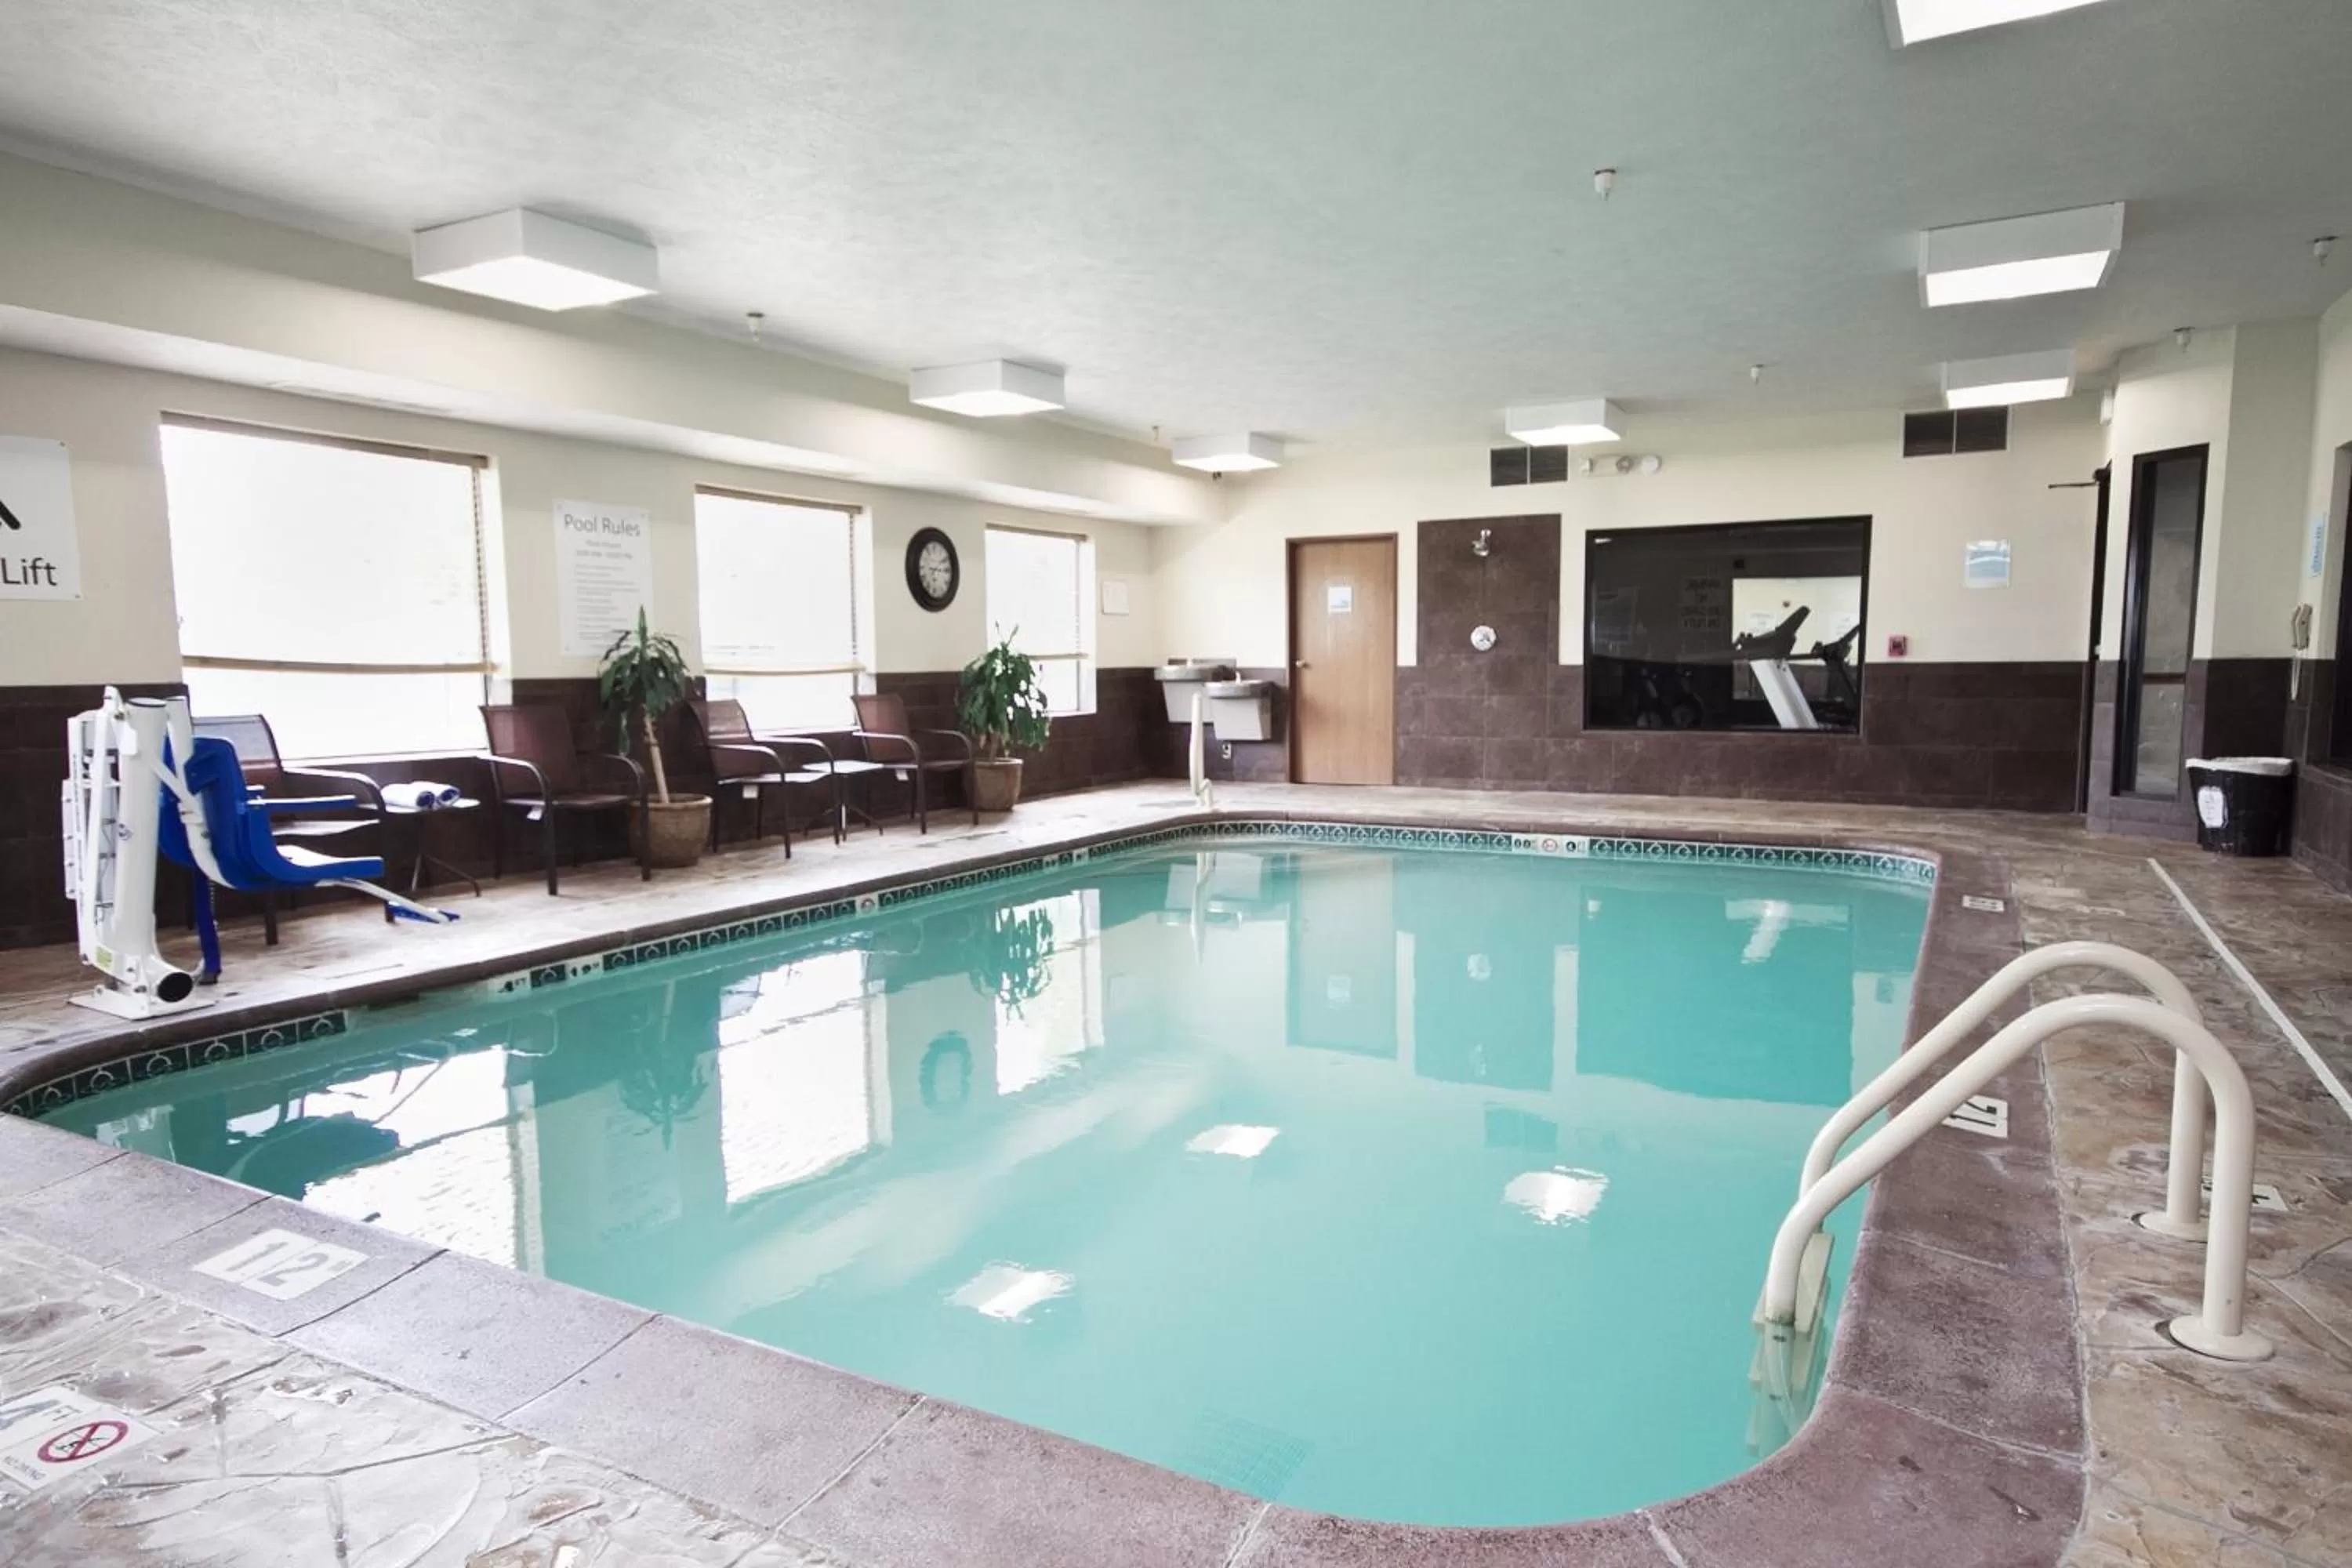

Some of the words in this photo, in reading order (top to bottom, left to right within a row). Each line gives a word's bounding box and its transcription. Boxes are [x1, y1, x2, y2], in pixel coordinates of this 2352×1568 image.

[564, 514, 598, 533] Pool
[601, 517, 641, 536] Rules
[1, 557, 57, 586] Lift
